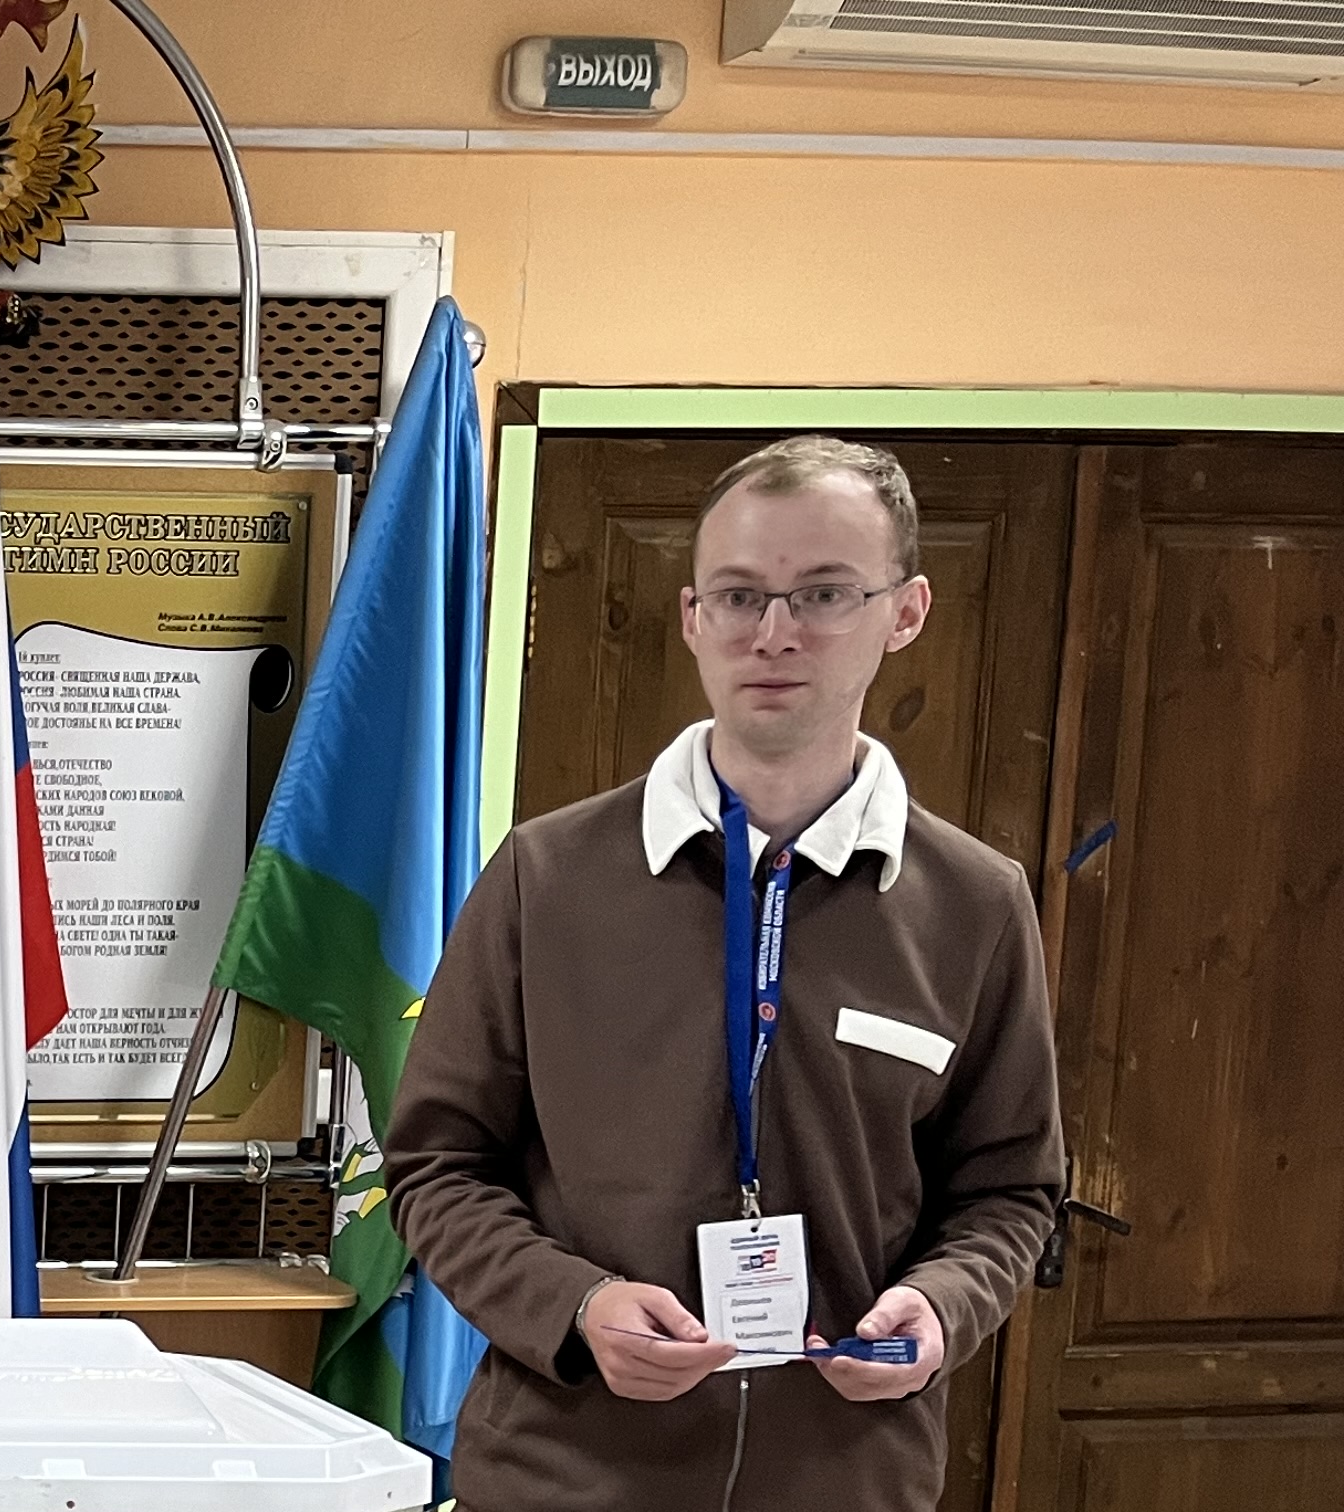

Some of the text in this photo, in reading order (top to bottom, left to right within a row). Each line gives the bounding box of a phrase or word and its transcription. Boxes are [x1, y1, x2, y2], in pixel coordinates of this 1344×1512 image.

[558, 54, 652, 91] ВЫХОД
[0, 511, 291, 545] СУДАРСТВЕННЫЙ
[2, 546, 239, 577] ГИМН РОССИИ
[60, 671, 120, 683] СВЯЩЕННАЯ
[122, 671, 151, 682] НАША
[112, 686, 141, 698] НАША
[25, 702, 60, 713] ОГУЧАЯ
[27, 717, 40, 728] ОЕ
[41, 717, 97, 729] ДОСТОЯНЬЕ
[99, 717, 112, 728] НА
[115, 717, 133, 729] ВСЕ
[36, 789, 61, 801] СКИХ
[64, 789, 107, 802] НАРОДОВ
[110, 789, 137, 801] СОЮЗ
[66, 805, 105, 817] ДАННАЯ
[40, 820, 61, 831] ОСТЬ
[55, 835, 94, 847] СТРАНА!
[66, 897, 99, 911] МОРЕЙ
[101, 900, 115, 912] ДО
[117, 899, 174, 911] ПОЛЯРНОГО
[175, 899, 200, 911] КРАЯ
[79, 914, 108, 926] НАШИ
[110, 914, 135, 926] ЛЕСА
[137, 915, 145, 925] И
[101, 930, 127, 942] ОДНА
[129, 930, 144, 941] ТЫ
[60, 945, 92, 956] БОГОМ
[94, 945, 131, 957] РОДНАЯ
[67, 1008, 98, 1019] ОСТОР
[99, 1008, 119, 1020] ДЛЯ
[121, 1008, 155, 1019] МЕЧТЫ
[158, 1008, 166, 1018] И
[167, 1008, 187, 1020] ДЛЯ
[79, 1023, 140, 1034] ОТКРЫВАЮТ
[52, 1038, 77, 1050] ДАЕТ
[79, 1038, 107, 1049] НАША
[109, 1038, 157, 1049] ВЕРНОСТЬ
[72, 1053, 96, 1064] ЕСТЬ
[98, 1053, 105, 1063] И
[108, 1053, 125, 1064] ТАК
[128, 1053, 157, 1065] БУДЕТ
